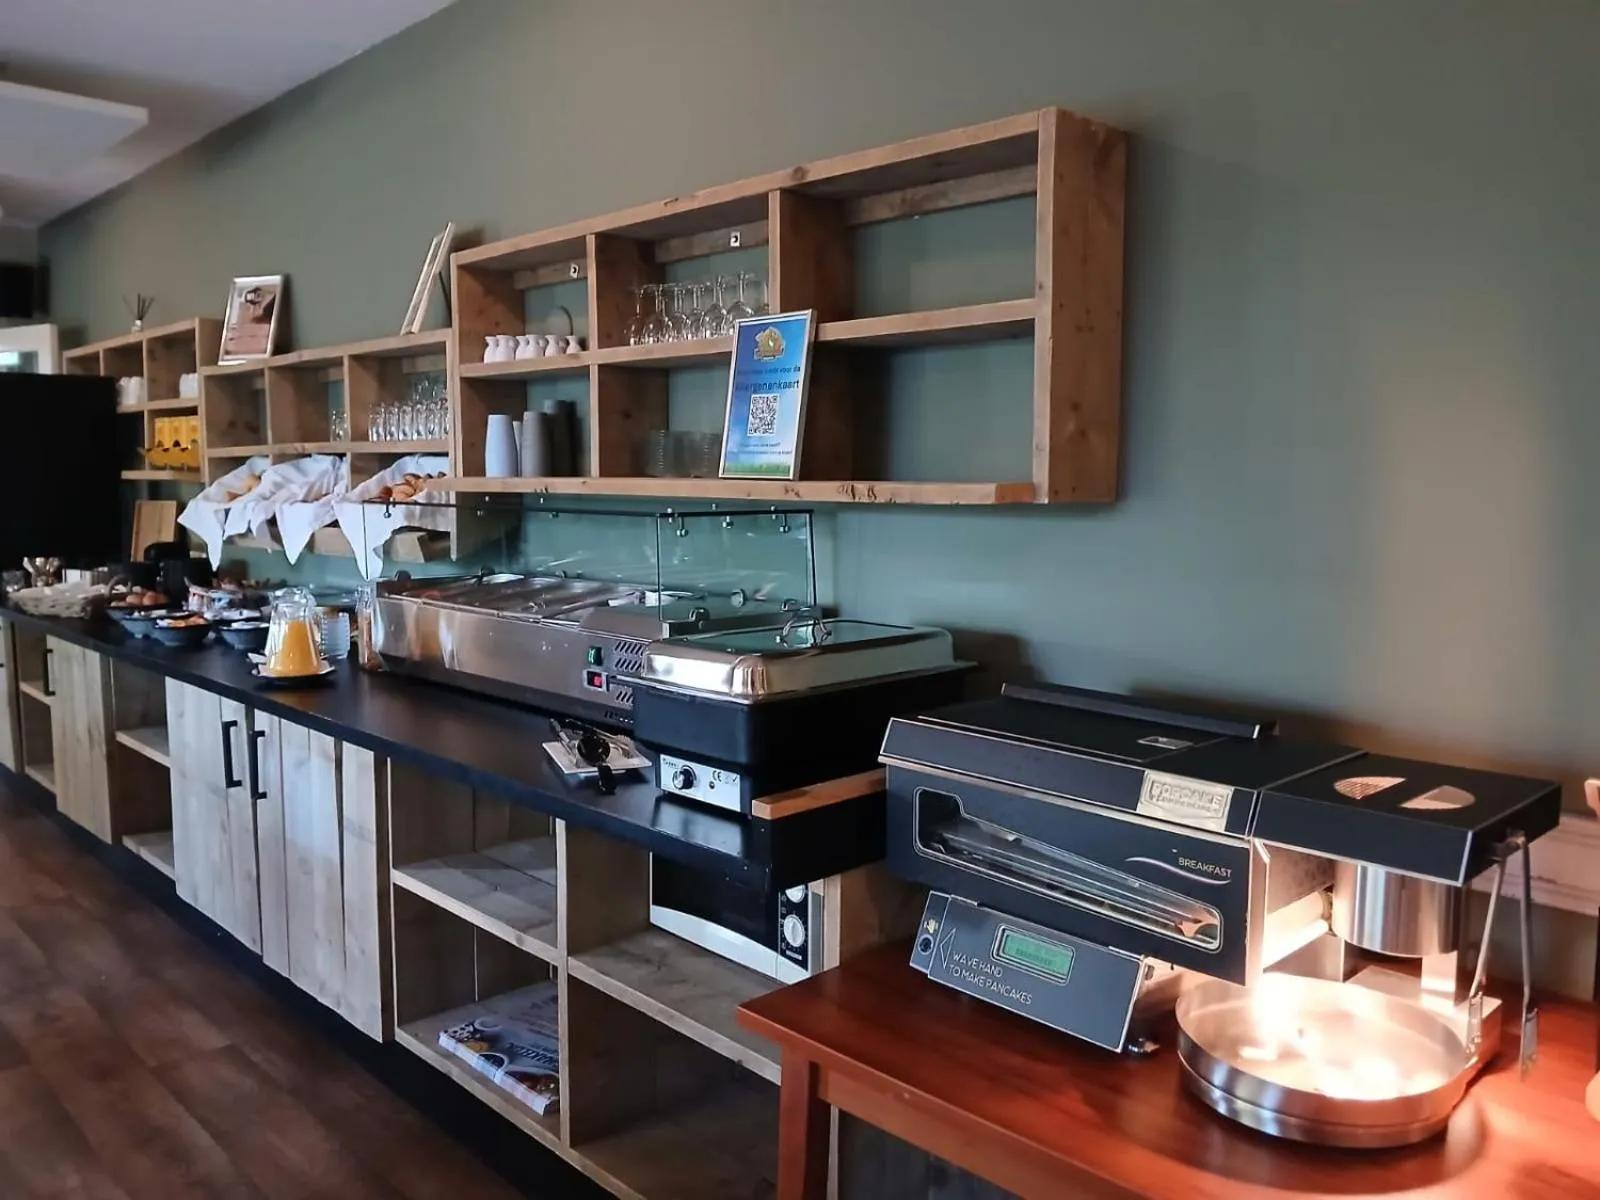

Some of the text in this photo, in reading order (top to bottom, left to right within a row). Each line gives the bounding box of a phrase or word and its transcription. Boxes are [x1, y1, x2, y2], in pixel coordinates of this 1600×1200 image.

[1178, 857, 1232, 878] BREAKFAST
[952, 952, 1003, 978] WAVE HAND
[949, 965, 1033, 1005] TO MAKE PANCAKES
